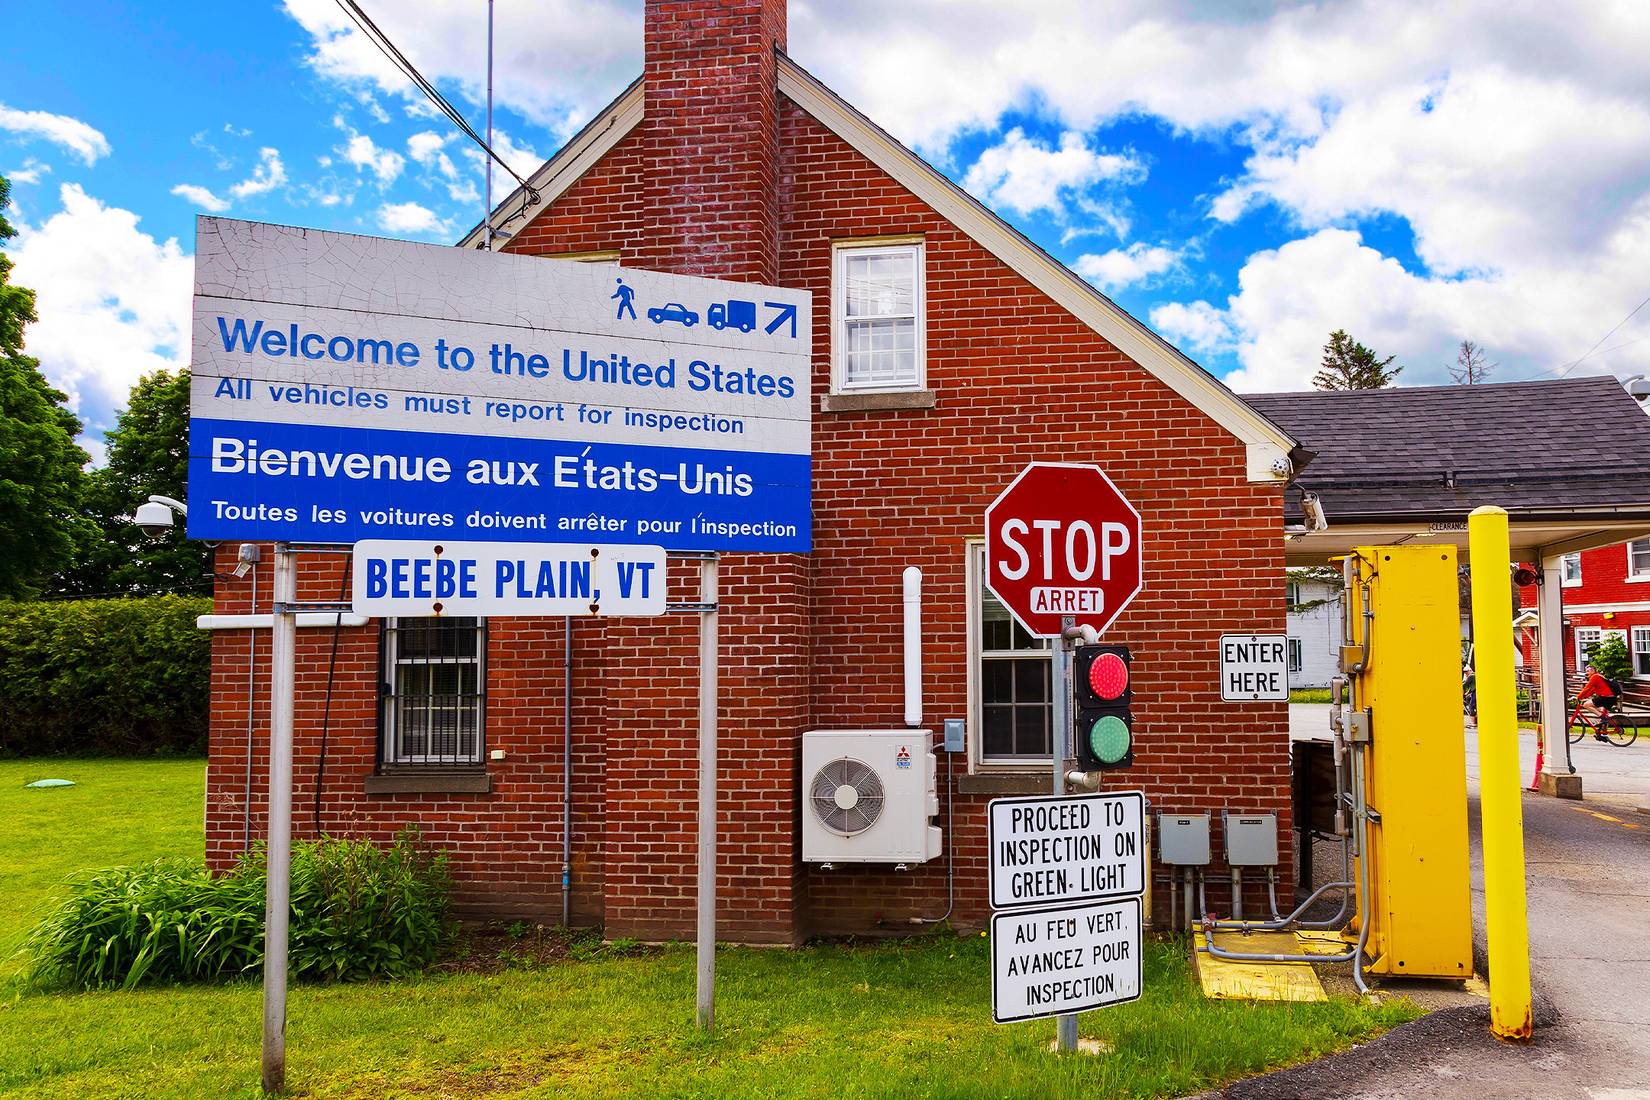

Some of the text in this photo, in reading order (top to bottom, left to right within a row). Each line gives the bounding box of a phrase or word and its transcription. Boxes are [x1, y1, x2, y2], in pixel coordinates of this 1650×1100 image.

[216, 316, 795, 398] Welcome to the United States
[214, 377, 744, 433] All vehicles must report for inspection
[211, 437, 451, 483] Bienvenue
[466, 458, 540, 486] aux
[211, 500, 298, 522] Toutes
[312, 505, 347, 523] les
[360, 507, 454, 526] voitures
[466, 511, 546, 530] doivent
[558, 512, 627, 531] arrêter
[637, 519, 682, 535] pour
[999, 518, 1130, 581] STOP
[366, 558, 655, 604] BEEBE PLAIN, VT
[1036, 589, 1099, 611] ARRET
[1225, 643, 1284, 663] ENTER
[1230, 672, 1280, 692] HERE
[1012, 801, 1124, 833] PROCEED TO
[1000, 831, 1135, 867] INSPECTION ON
[1012, 864, 1126, 898] GREEN LIGHT
[1015, 923, 1037, 944] AU
[1047, 918, 1077, 940] FEU
[1008, 940, 1129, 977] AVANCEZ POUR
[1026, 973, 1114, 1006] INSPECTION
